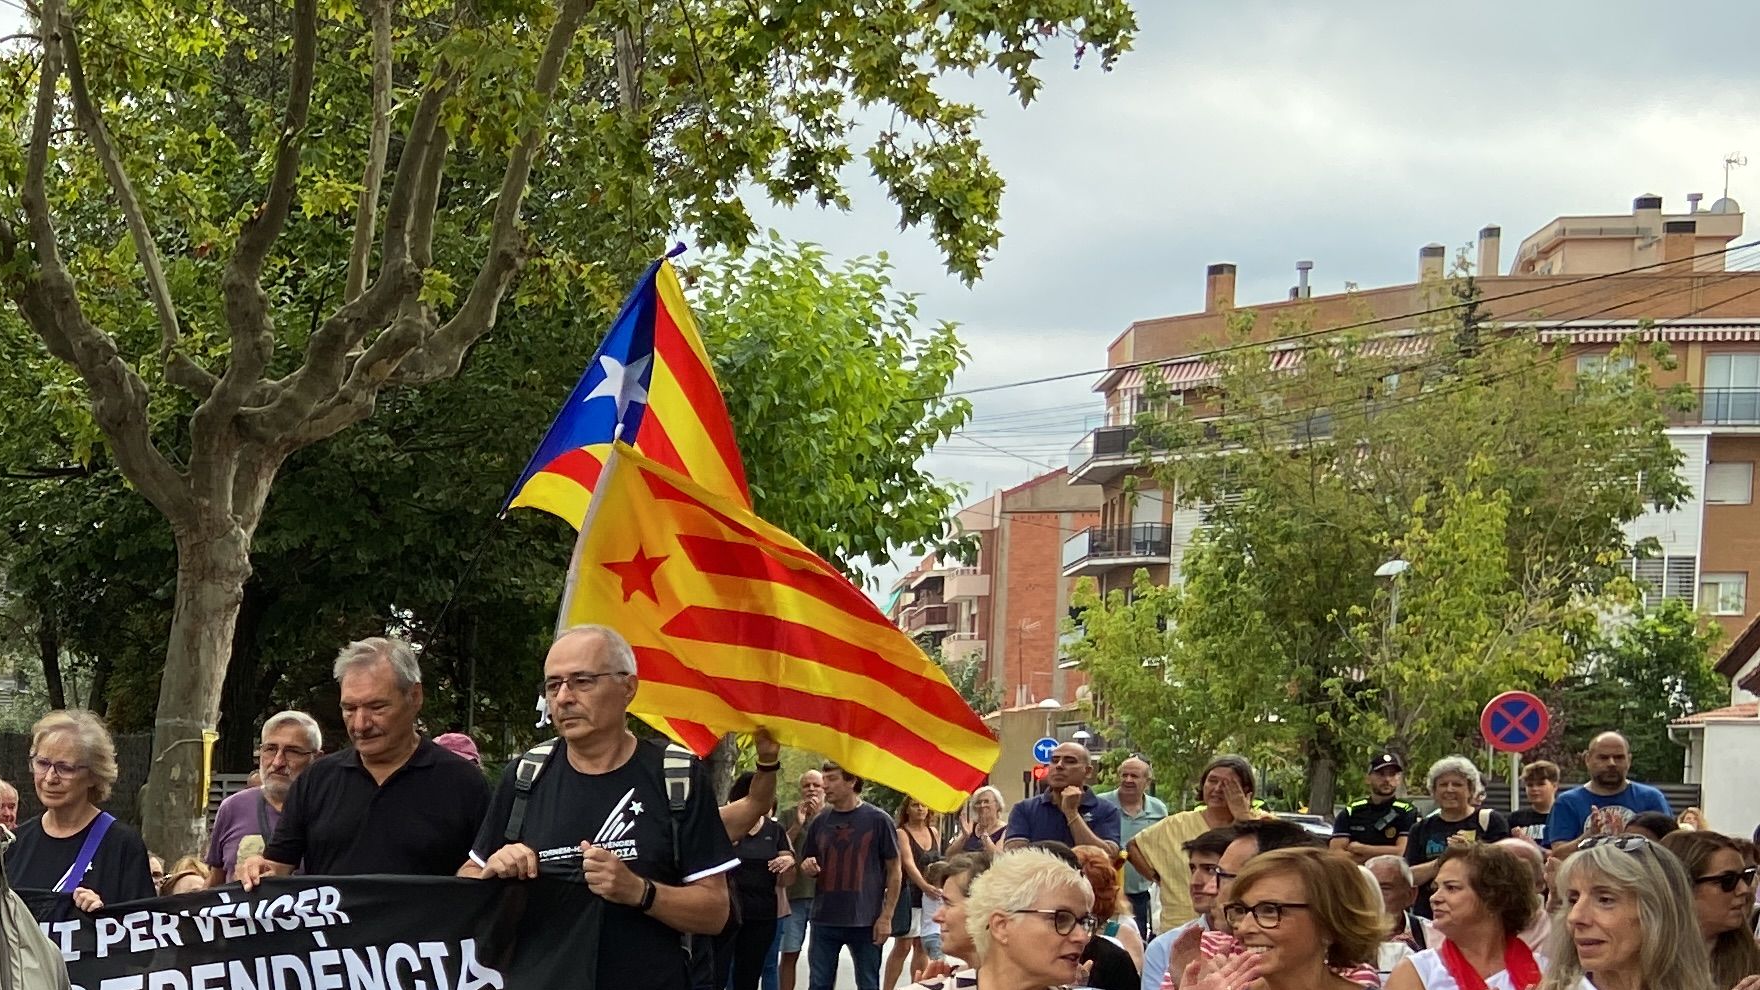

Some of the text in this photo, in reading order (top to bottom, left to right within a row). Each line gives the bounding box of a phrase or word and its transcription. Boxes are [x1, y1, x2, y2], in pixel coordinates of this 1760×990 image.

[539, 846, 582, 859] TORNEM-H
[96, 910, 184, 958] PER
[185, 885, 351, 942] VÈNCER
